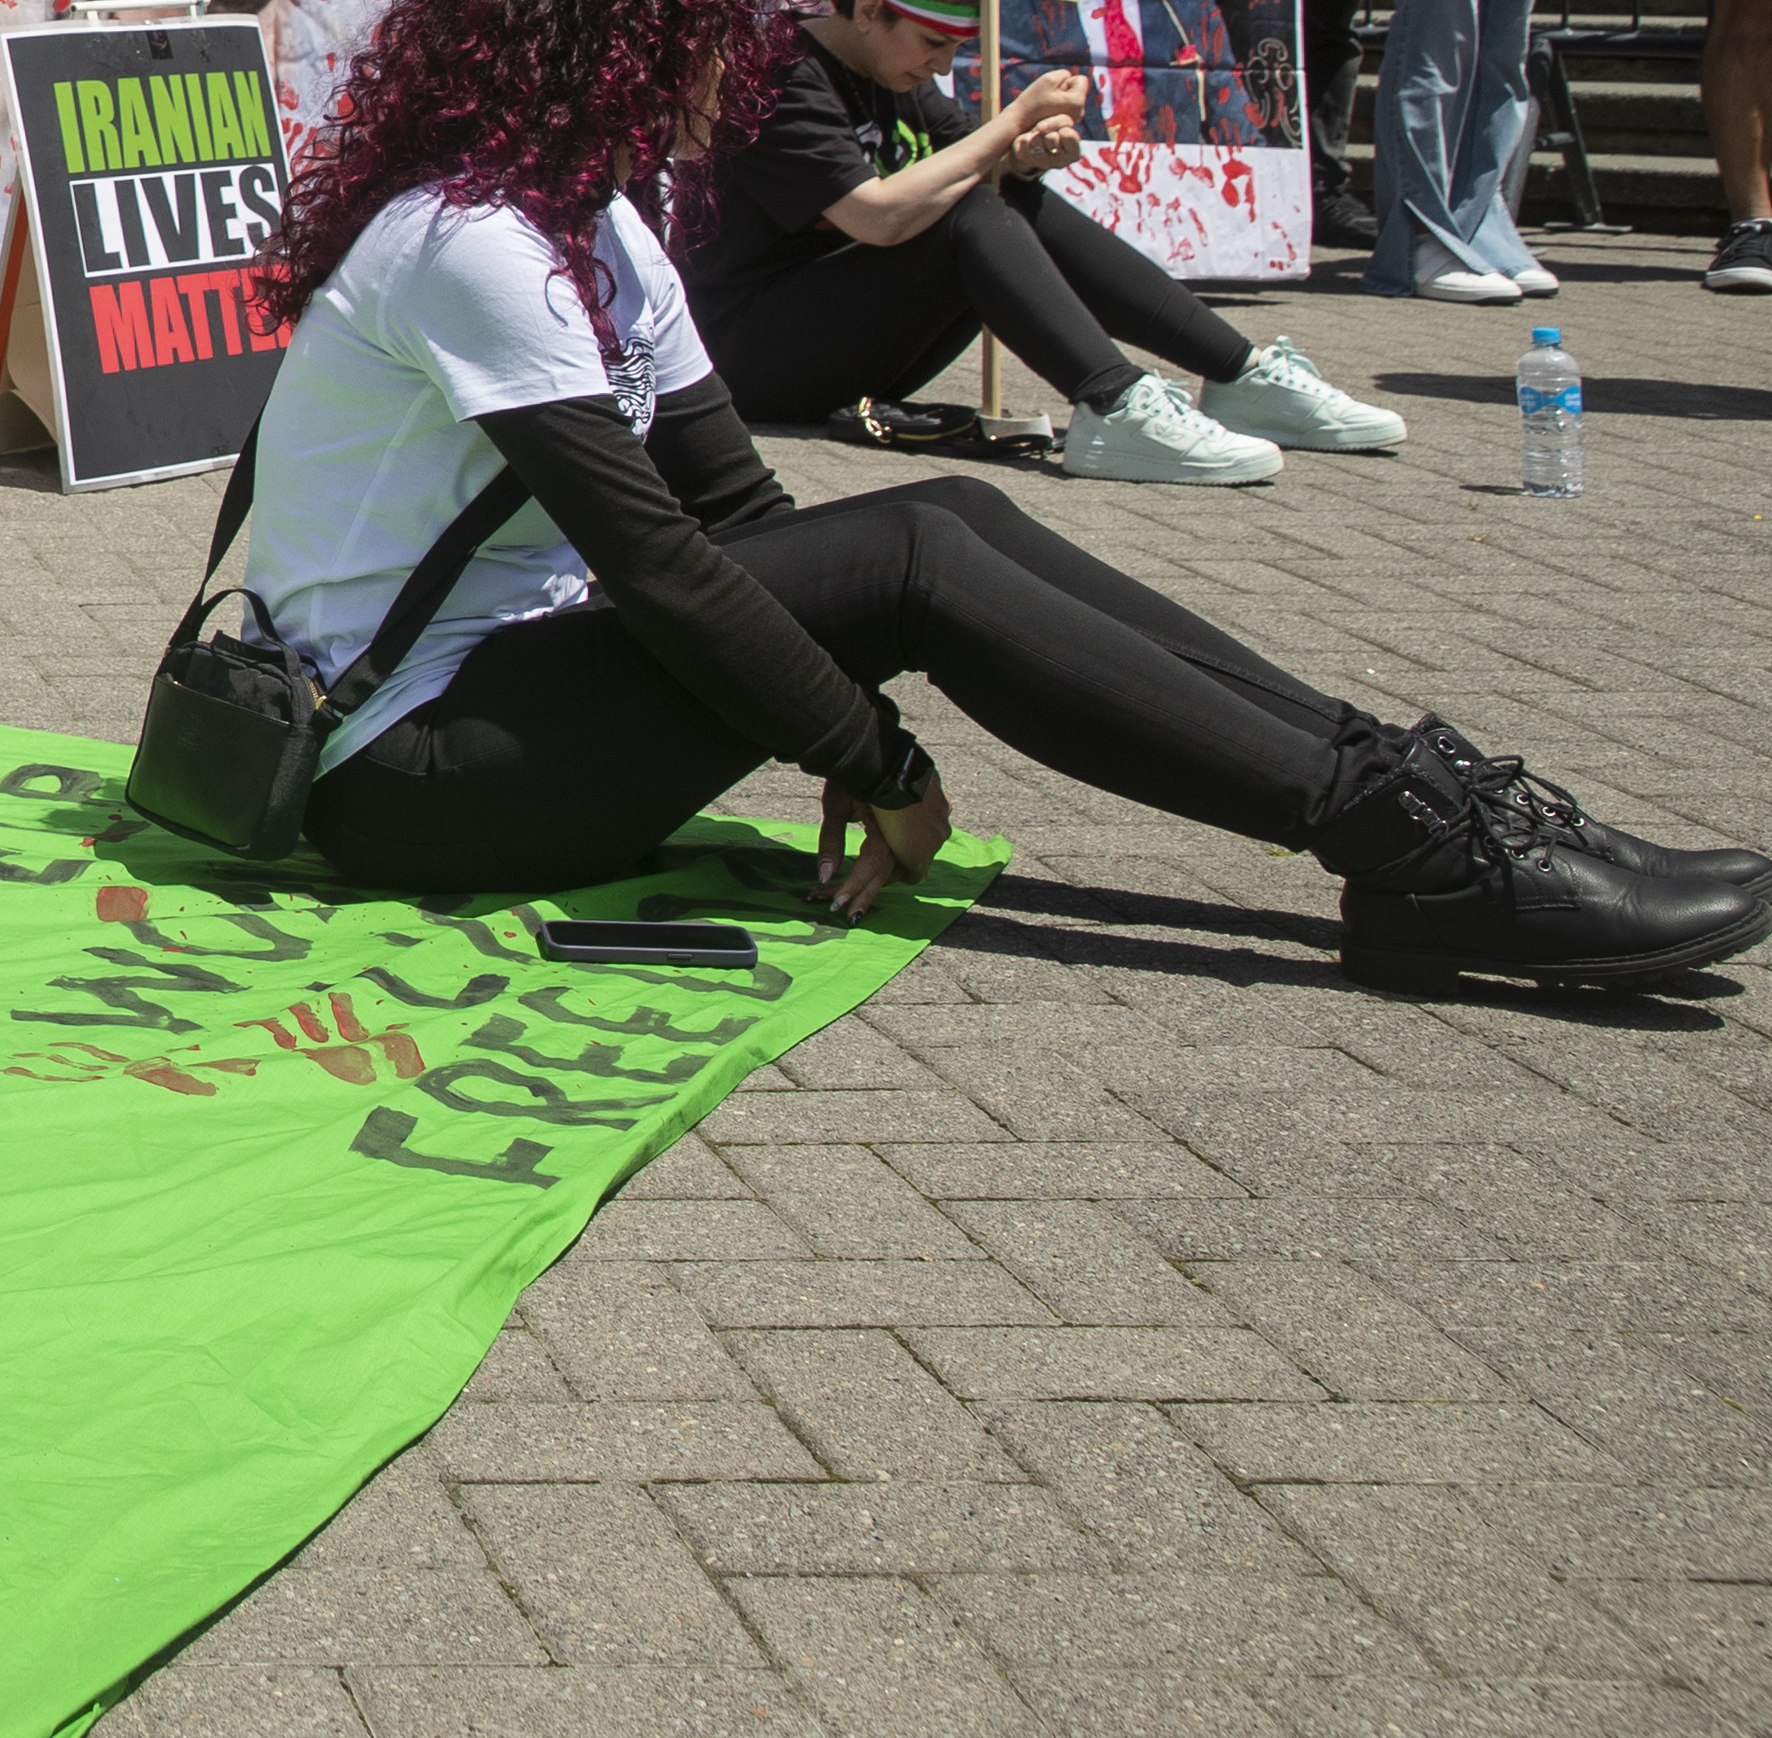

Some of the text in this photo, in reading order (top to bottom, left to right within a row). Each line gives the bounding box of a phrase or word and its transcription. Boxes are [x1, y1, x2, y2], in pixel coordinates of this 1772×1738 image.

[52, 69, 272, 174] IRANIAN
[71, 164, 282, 273] LIVES
[88, 262, 296, 375] MATTE
